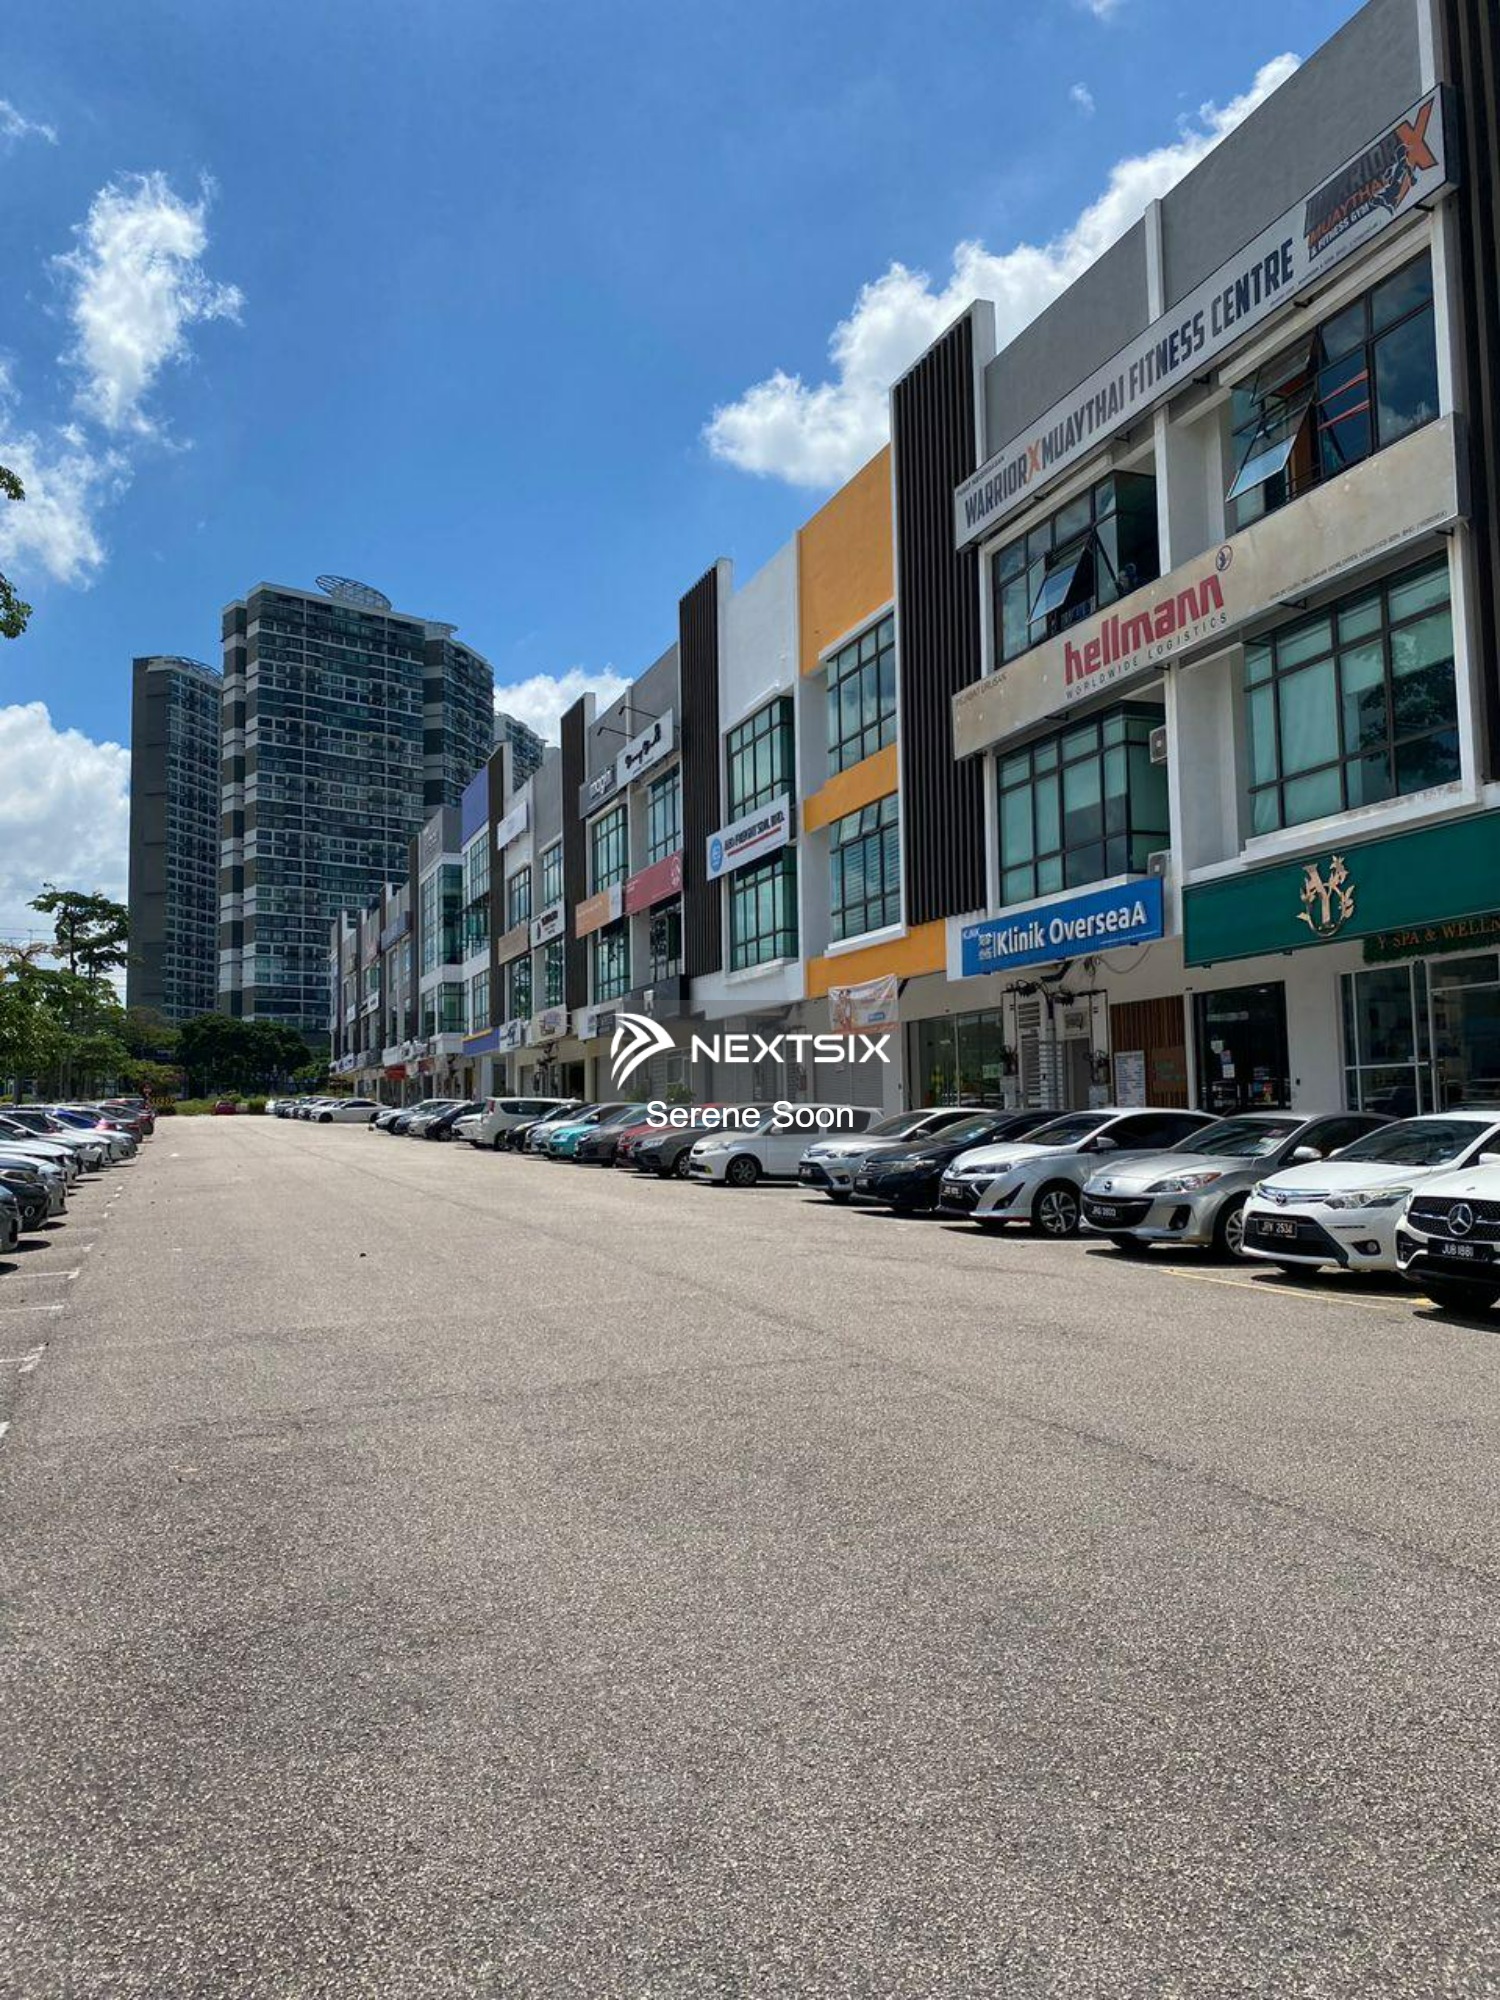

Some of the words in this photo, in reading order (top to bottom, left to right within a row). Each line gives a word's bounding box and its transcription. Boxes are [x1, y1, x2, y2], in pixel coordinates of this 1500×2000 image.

[1129, 310, 1206, 402] FITNESS
[1211, 237, 1295, 338] CENTRE
[1064, 574, 1224, 687] hellmann
[1066, 659, 1138, 699] WORLDWIDE
[1148, 611, 1227, 659] LOGISTICS
[997, 921, 1046, 956] Klinik
[1049, 900, 1148, 945] OverseaA
[1393, 930, 1421, 949] SPA
[1425, 927, 1438, 943] &
